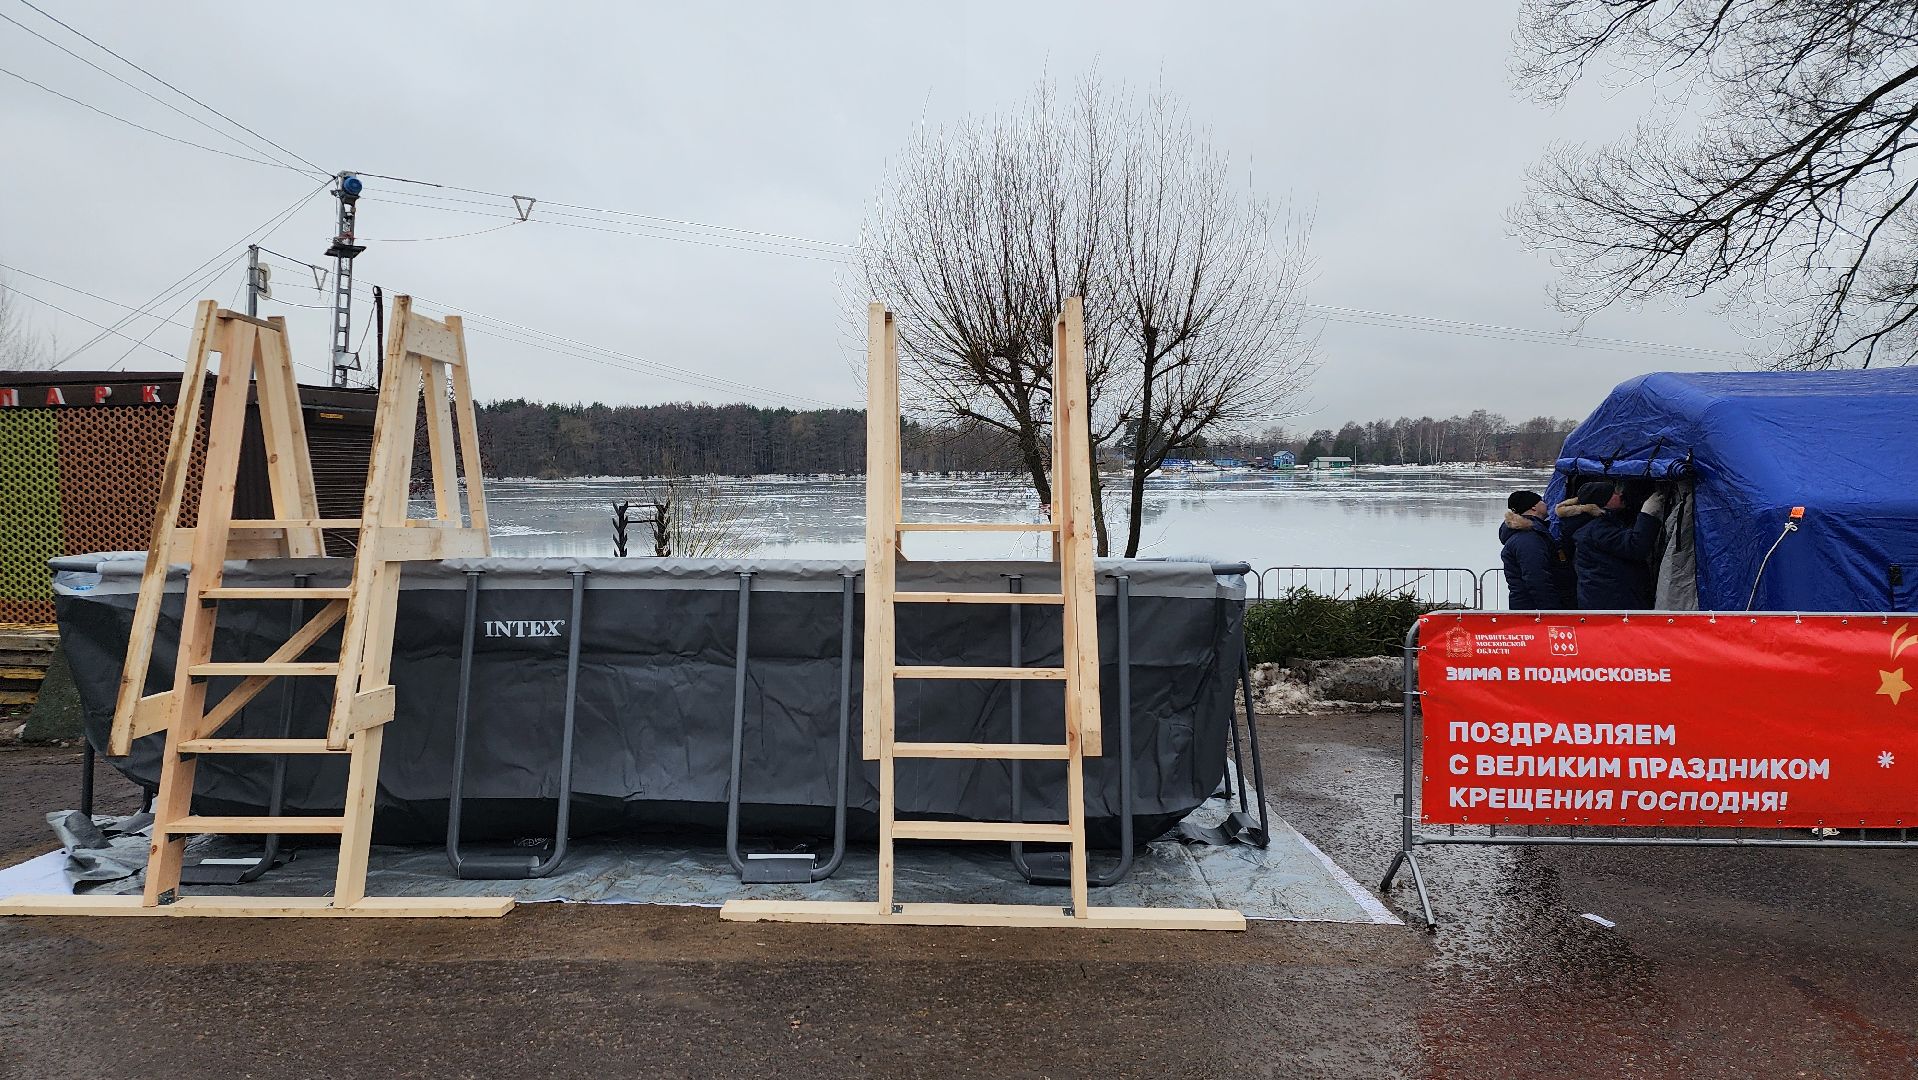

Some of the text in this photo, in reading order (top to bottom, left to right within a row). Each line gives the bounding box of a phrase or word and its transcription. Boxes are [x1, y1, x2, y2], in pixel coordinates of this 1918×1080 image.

[0, 385, 161, 407] ПАРК
[483, 620, 562, 637] INTEX
[1445, 666, 1672, 684] ЗИМА В ПОДМОСКОВЬЕ
[1449, 721, 1676, 747] ПОЗДРАВЛЯЕМ
[1449, 753, 1830, 782] С ВЕЛИКИМ ПРАЗДНИКОМ
[1449, 786, 1788, 814] КРЕЩЕНИЯ ГОСПОДНЯ!
